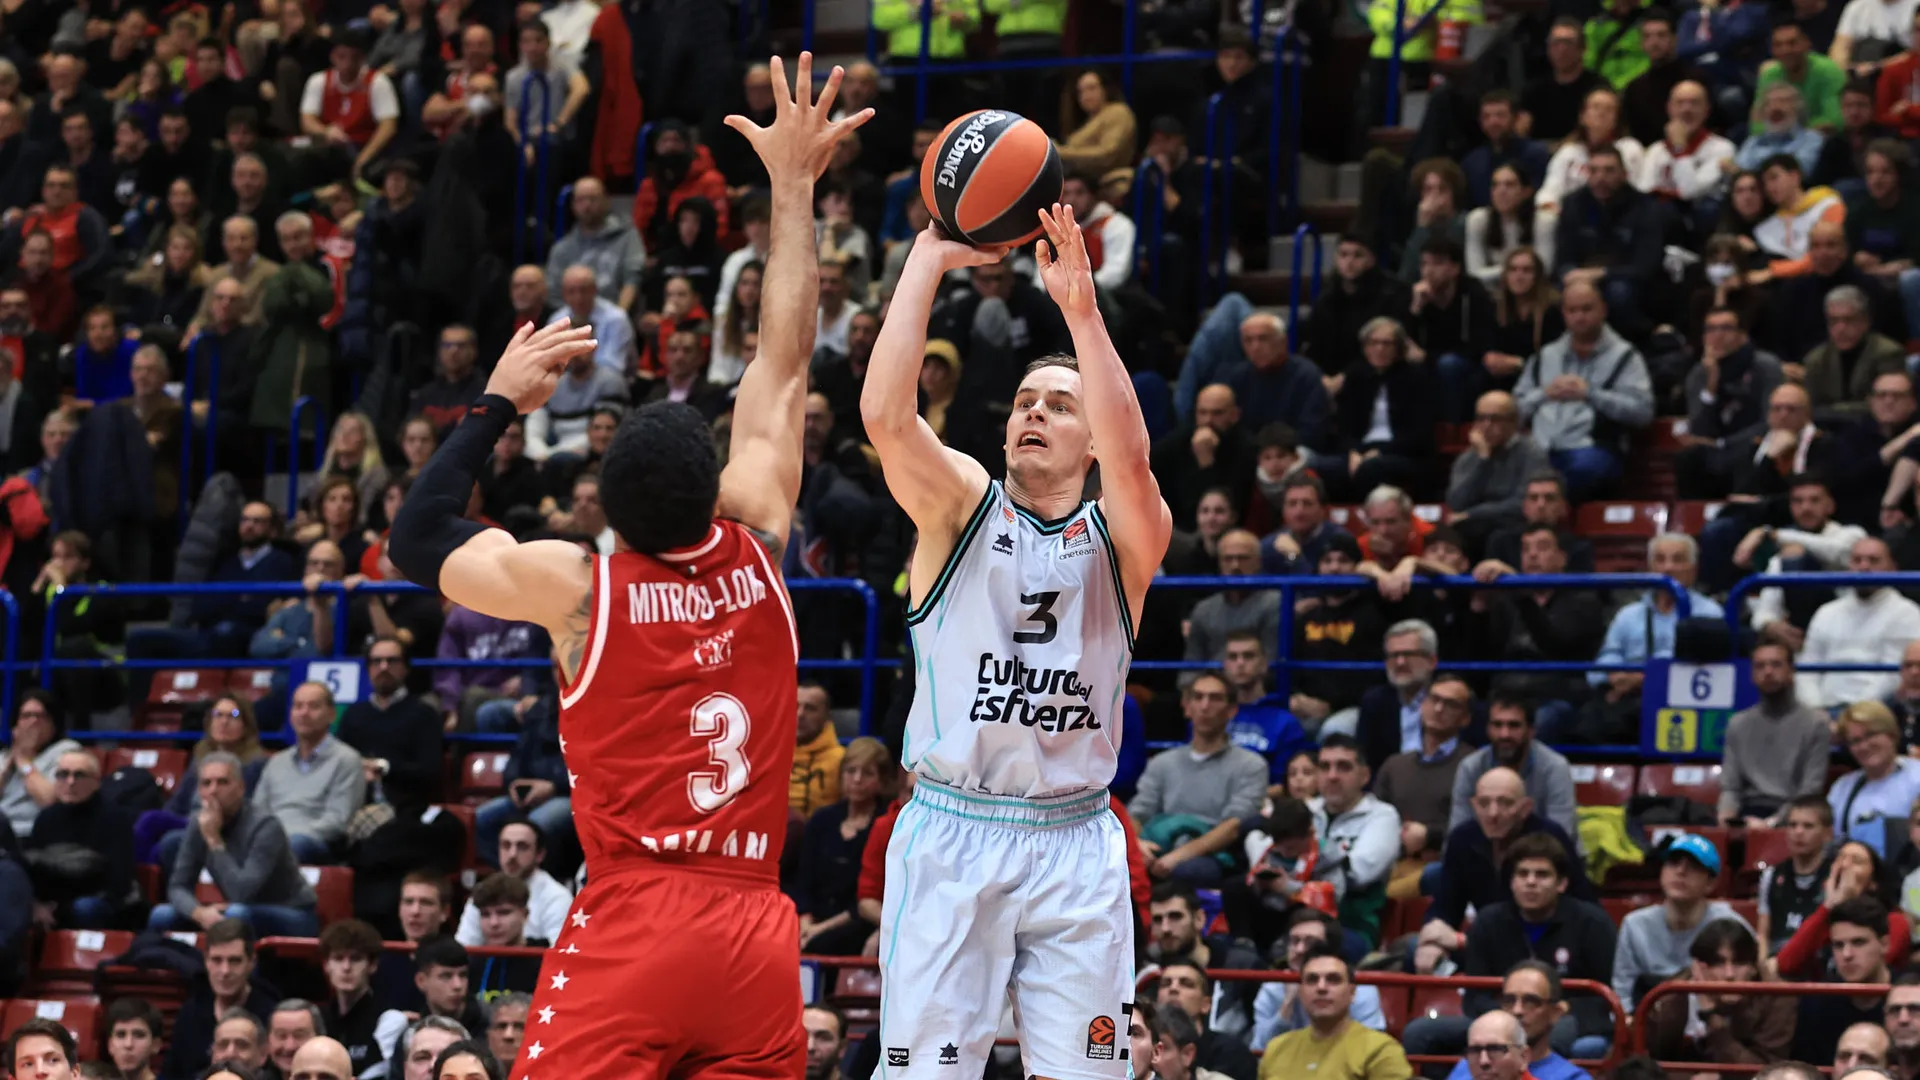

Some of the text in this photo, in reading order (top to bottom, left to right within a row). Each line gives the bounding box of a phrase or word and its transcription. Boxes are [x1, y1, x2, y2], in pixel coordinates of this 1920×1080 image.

[1012, 591, 1061, 645] 3
[325, 668, 342, 695] 5
[1690, 669, 1712, 702] 6
[687, 691, 752, 815] 3
